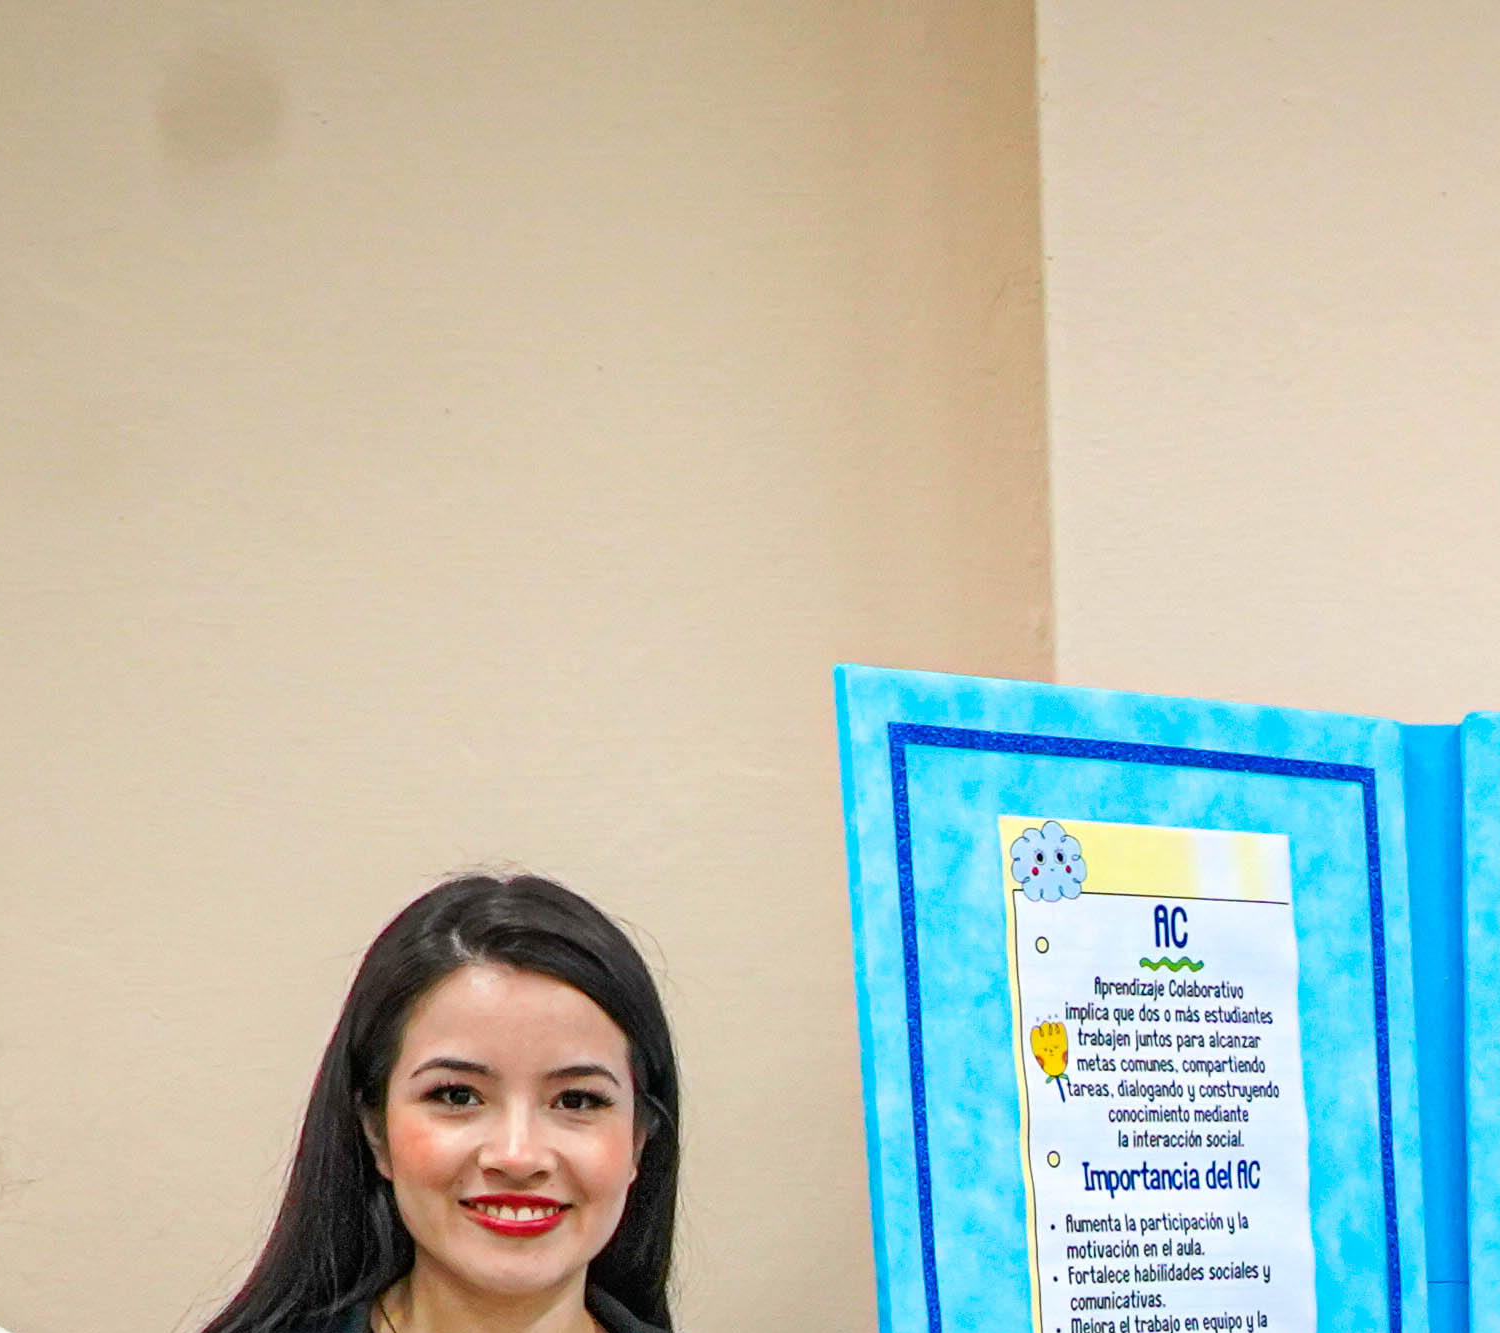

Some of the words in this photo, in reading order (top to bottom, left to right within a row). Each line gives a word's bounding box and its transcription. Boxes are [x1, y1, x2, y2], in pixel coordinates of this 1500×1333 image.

[1154, 905, 1188, 948] AC
[1095, 976, 1164, 1001] Aprendizaje
[1169, 979, 1243, 999] Colaborativo
[1065, 1002, 1109, 1025] implica
[1113, 1008, 1134, 1026] que
[1139, 1004, 1160, 1022] dos
[1164, 1010, 1170, 1022] o
[1175, 1006, 1200, 1022] más
[1205, 1007, 1273, 1024] estudiantes
[1078, 1028, 1130, 1051] trabajen
[1136, 1030, 1172, 1051] juntos
[1177, 1035, 1204, 1052] para
[1209, 1032, 1261, 1048] alcanzar
[1082, 1161, 1200, 1199] Importancia
[1206, 1161, 1232, 1189] del
[1238, 1160, 1260, 1189] AC
